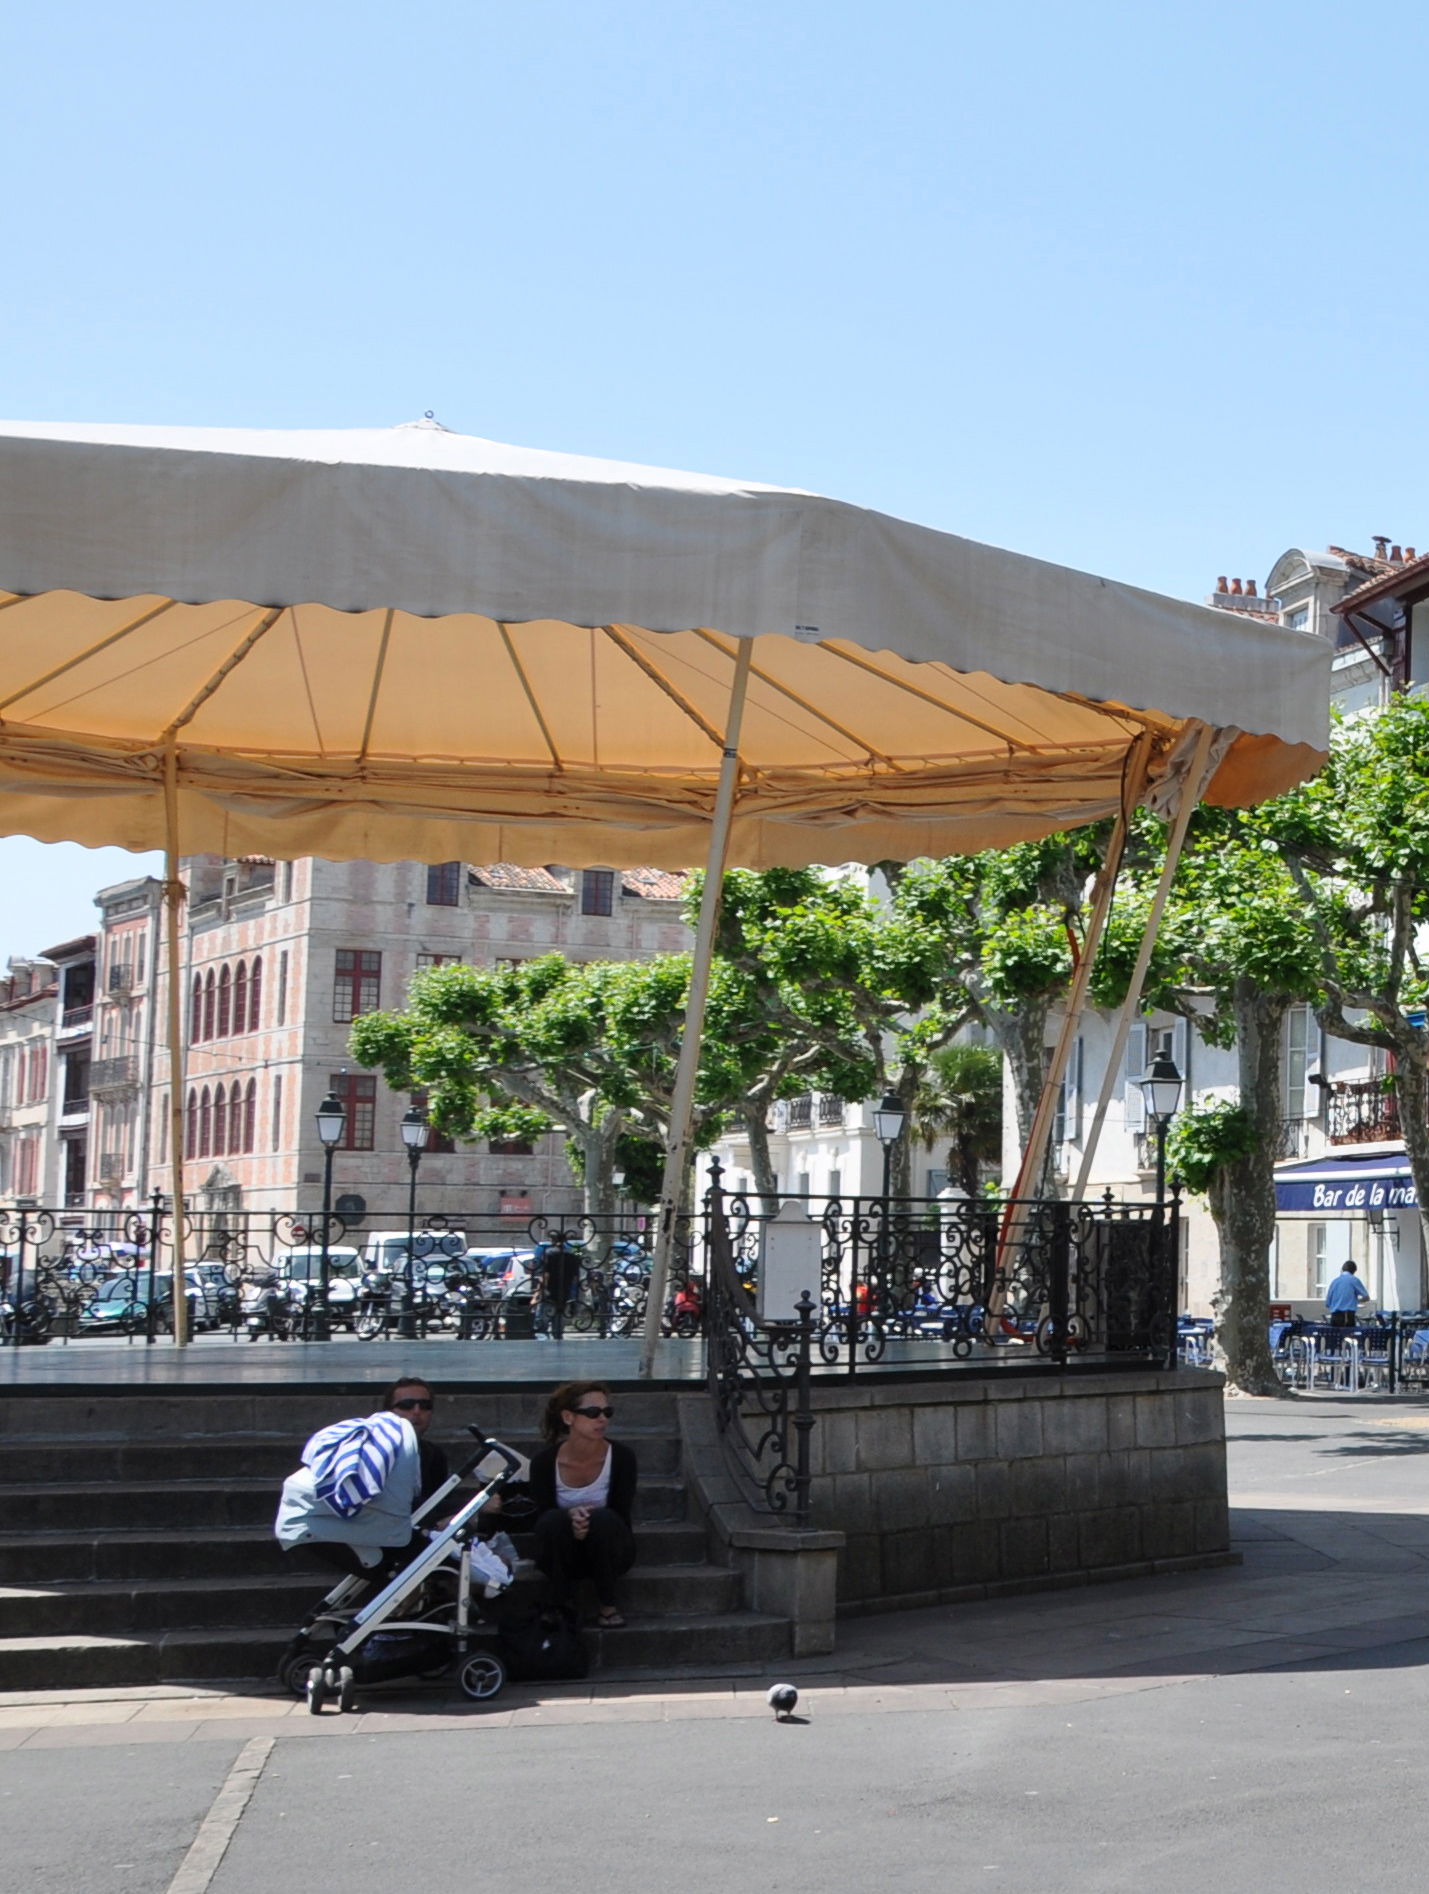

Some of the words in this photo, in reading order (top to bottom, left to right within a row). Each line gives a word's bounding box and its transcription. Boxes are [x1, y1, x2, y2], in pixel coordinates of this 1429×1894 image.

[1313, 1184, 1342, 1207] Bar
[1345, 1184, 1366, 1206] de
[1369, 1183, 1385, 1205] la
